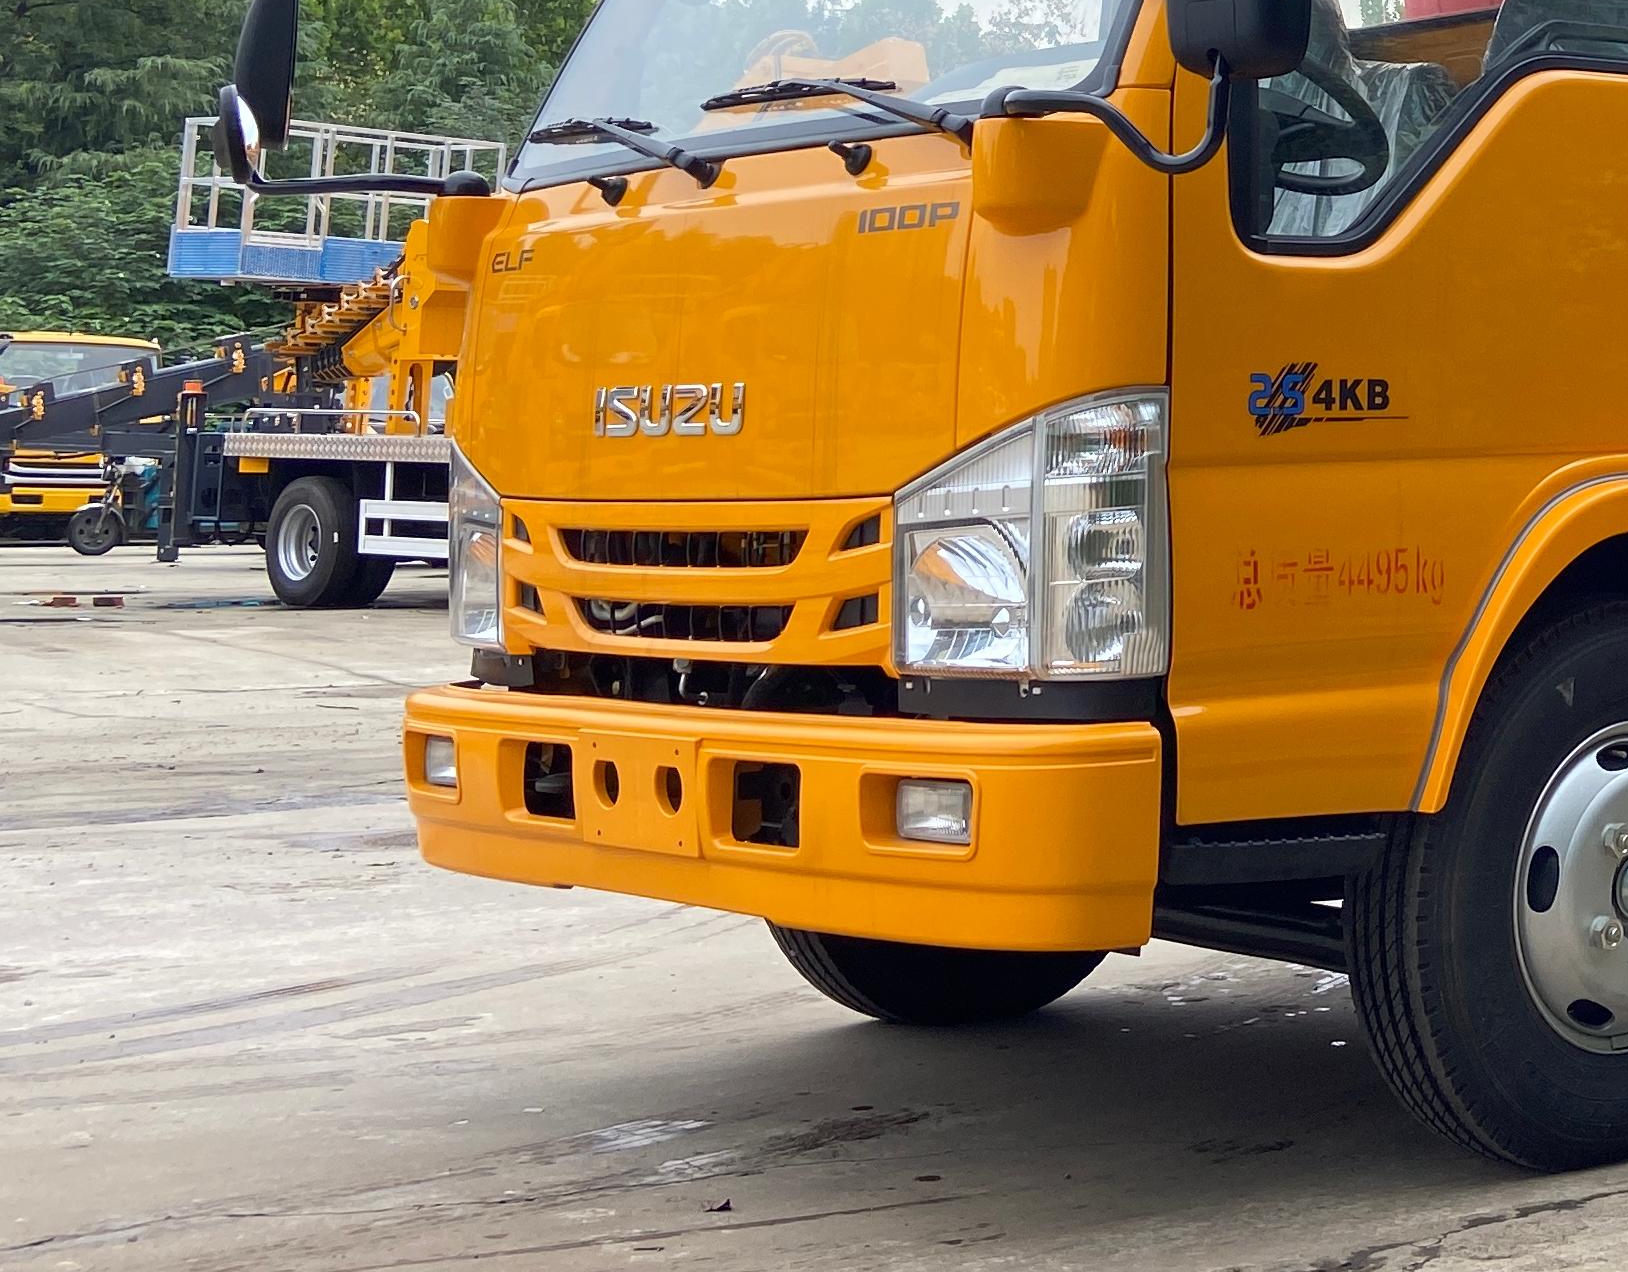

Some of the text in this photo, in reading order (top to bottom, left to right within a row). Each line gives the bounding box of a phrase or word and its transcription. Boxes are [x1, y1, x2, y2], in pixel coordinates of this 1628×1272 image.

[857, 201, 960, 234] 100P
[491, 249, 536, 273] ELF
[594, 382, 745, 437] ISUZU
[1312, 379, 1390, 411] 4KB
